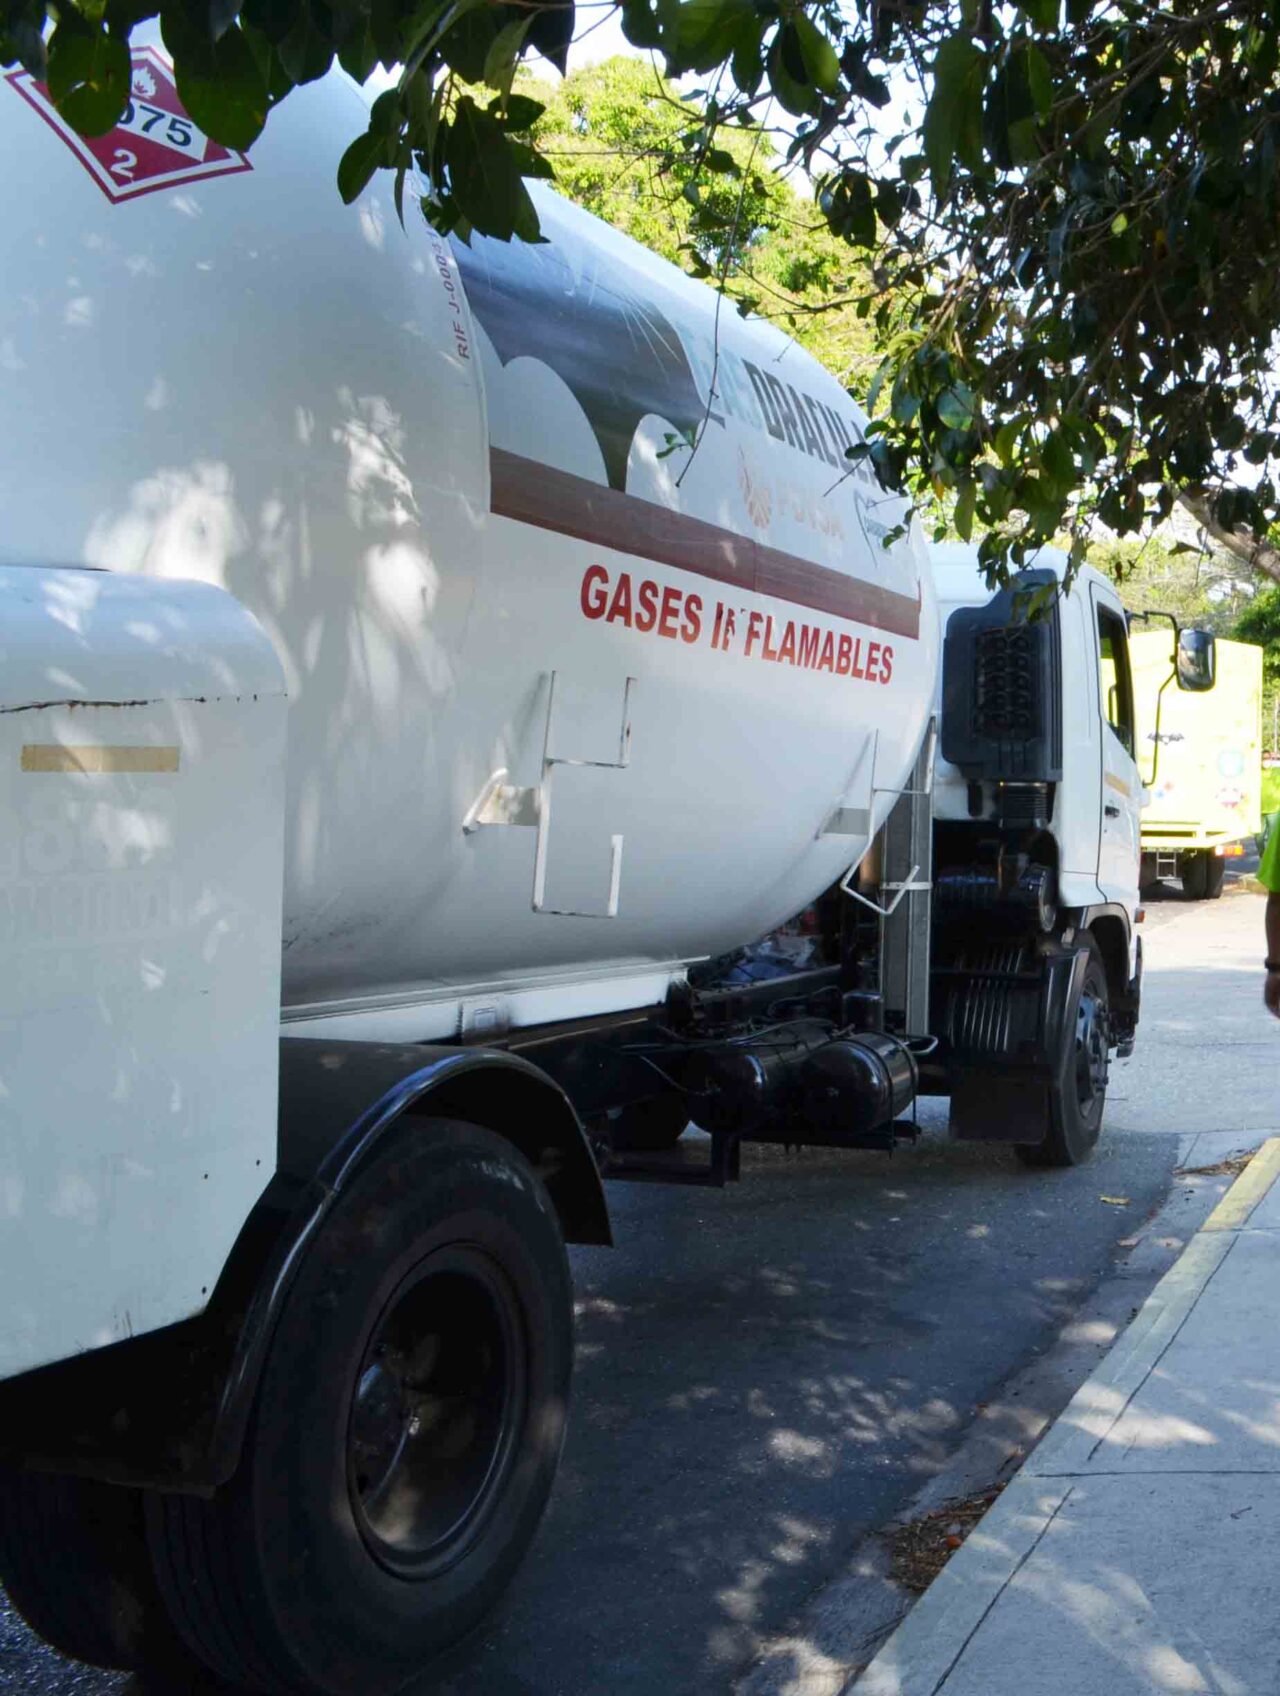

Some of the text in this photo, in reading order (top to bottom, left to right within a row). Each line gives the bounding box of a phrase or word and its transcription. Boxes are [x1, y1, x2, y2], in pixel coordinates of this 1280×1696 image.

[110, 148, 138, 179] 2
[453, 320, 470, 360] RIF
[580, 563, 703, 645] GASES
